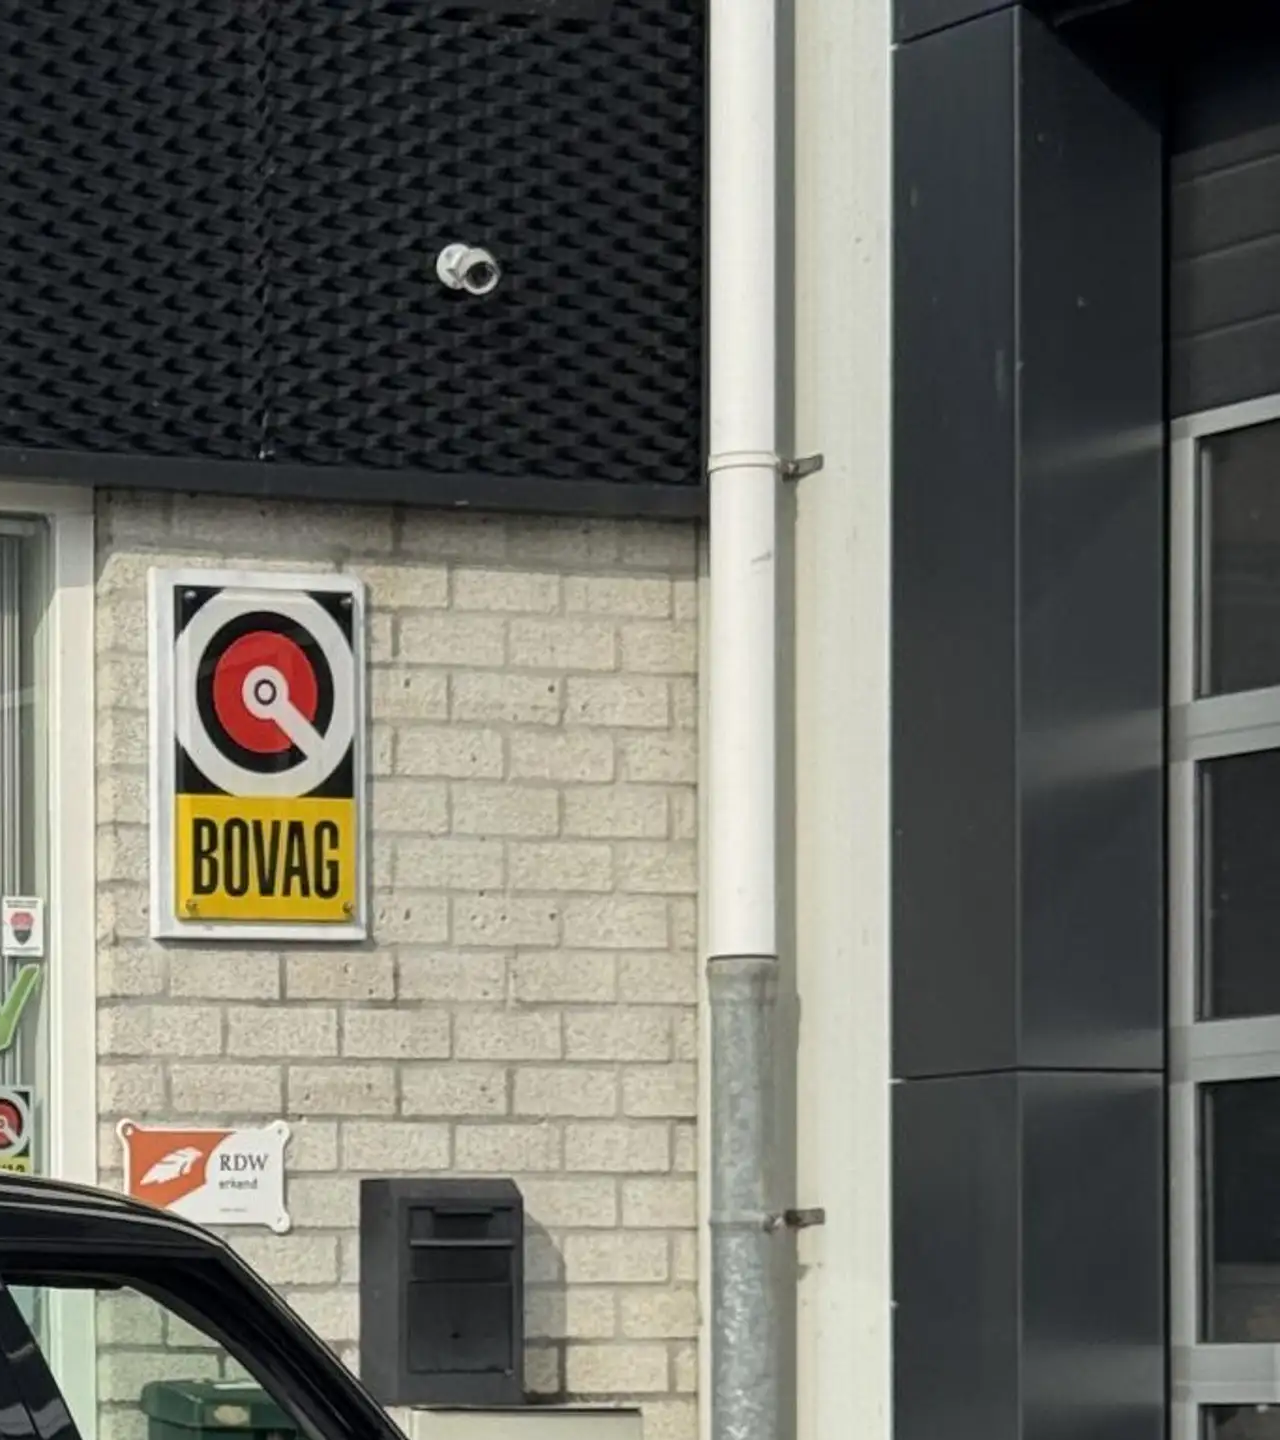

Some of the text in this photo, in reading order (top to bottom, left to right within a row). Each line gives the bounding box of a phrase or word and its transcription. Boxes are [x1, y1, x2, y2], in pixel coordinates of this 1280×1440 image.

[192, 816, 340, 900] BOVAG
[220, 1154, 268, 1171] RDW
[219, 1178, 258, 1190] erkend
